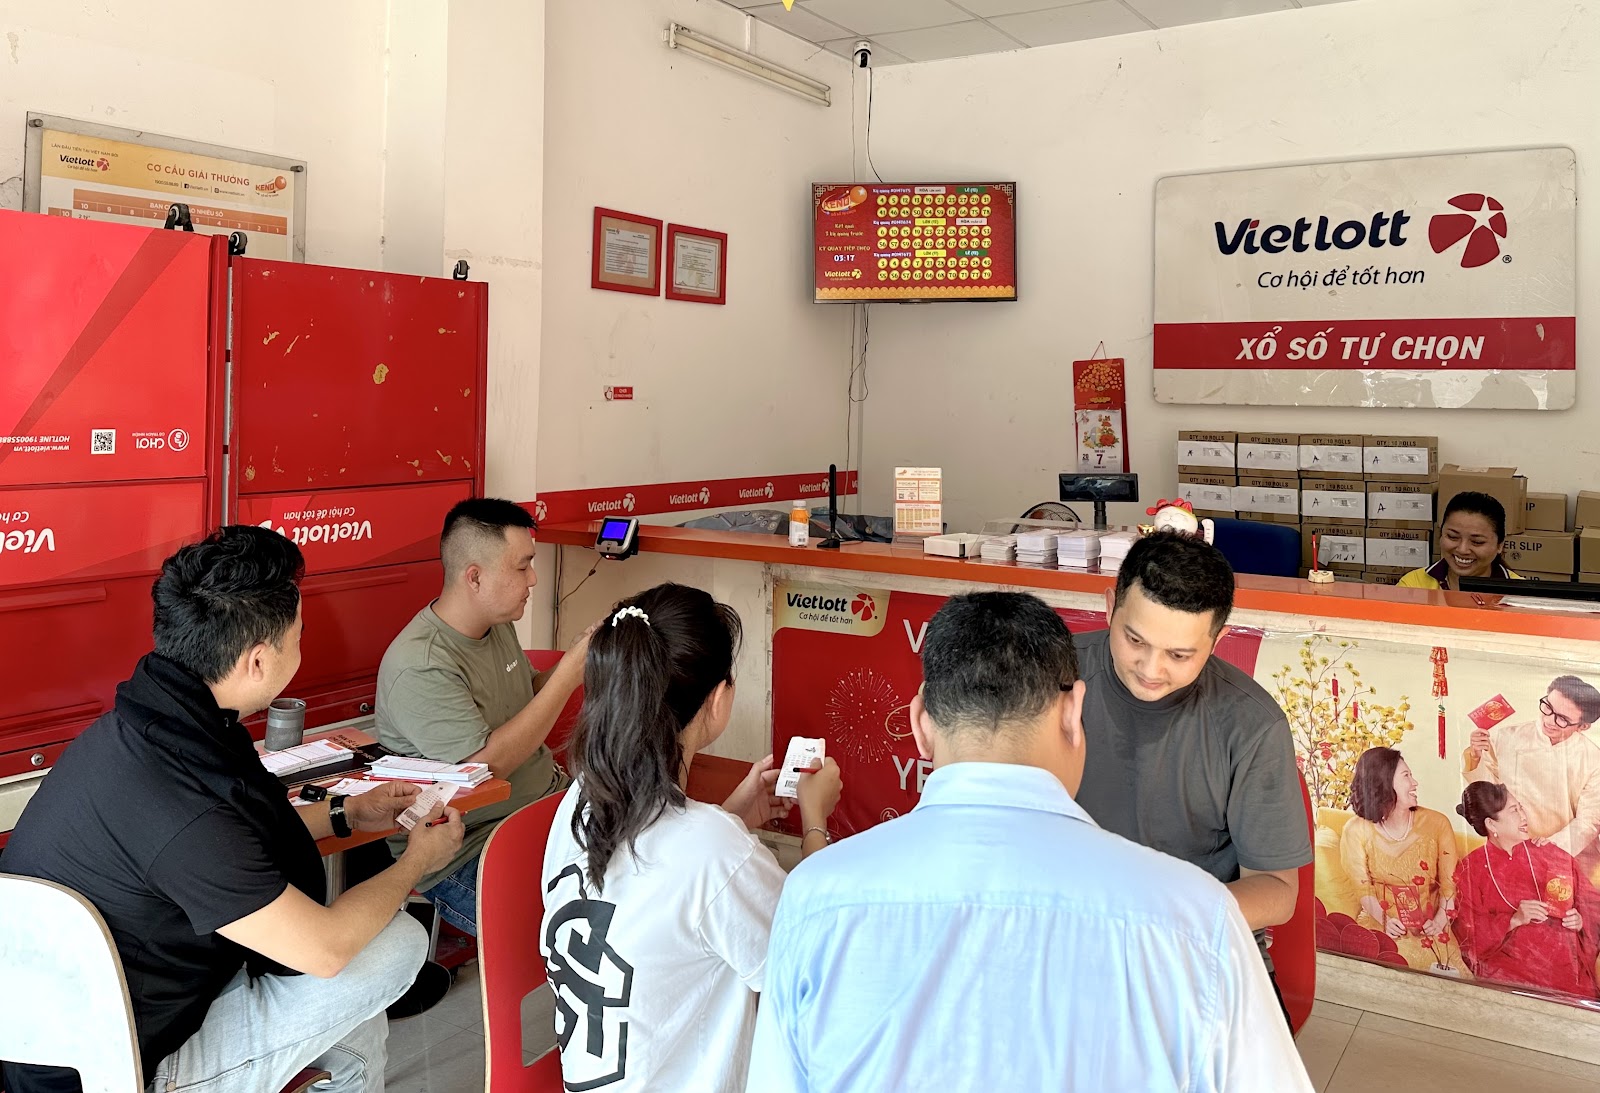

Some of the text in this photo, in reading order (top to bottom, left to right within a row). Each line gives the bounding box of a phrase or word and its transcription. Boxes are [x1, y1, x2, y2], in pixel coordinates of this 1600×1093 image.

[60, 154, 94, 166] Vietlott
[146, 163, 250, 186] CƠ CẤU GIẢI THƯỞNG
[255, 183, 275, 191] KENO
[1214, 209, 1411, 254] Vietlott
[1257, 264, 1426, 291] Cơ hội để tốt hơn
[1235, 324, 1485, 368] XỔ SỐ TỰ CHỌN
[135, 438, 165, 449] CHƠI
[1096, 454, 1103, 465] 7
[739, 486, 764, 498] Vietlott
[799, 482, 820, 494] Vietlott
[669, 492, 698, 505] Vietlott
[588, 500, 621, 513] Vietlott
[12, 511, 29, 523] Cơ
[284, 506, 355, 522] Cơ hội để tốt hơn
[292, 520, 373, 546] Vietlott
[1520, 541, 1542, 552] SLIP
[786, 592, 848, 612] Vietlott
[809, 612, 819, 623] hội
[820, 613, 829, 623] để
[829, 614, 839, 623] tốt
[840, 615, 853, 624] hơn
